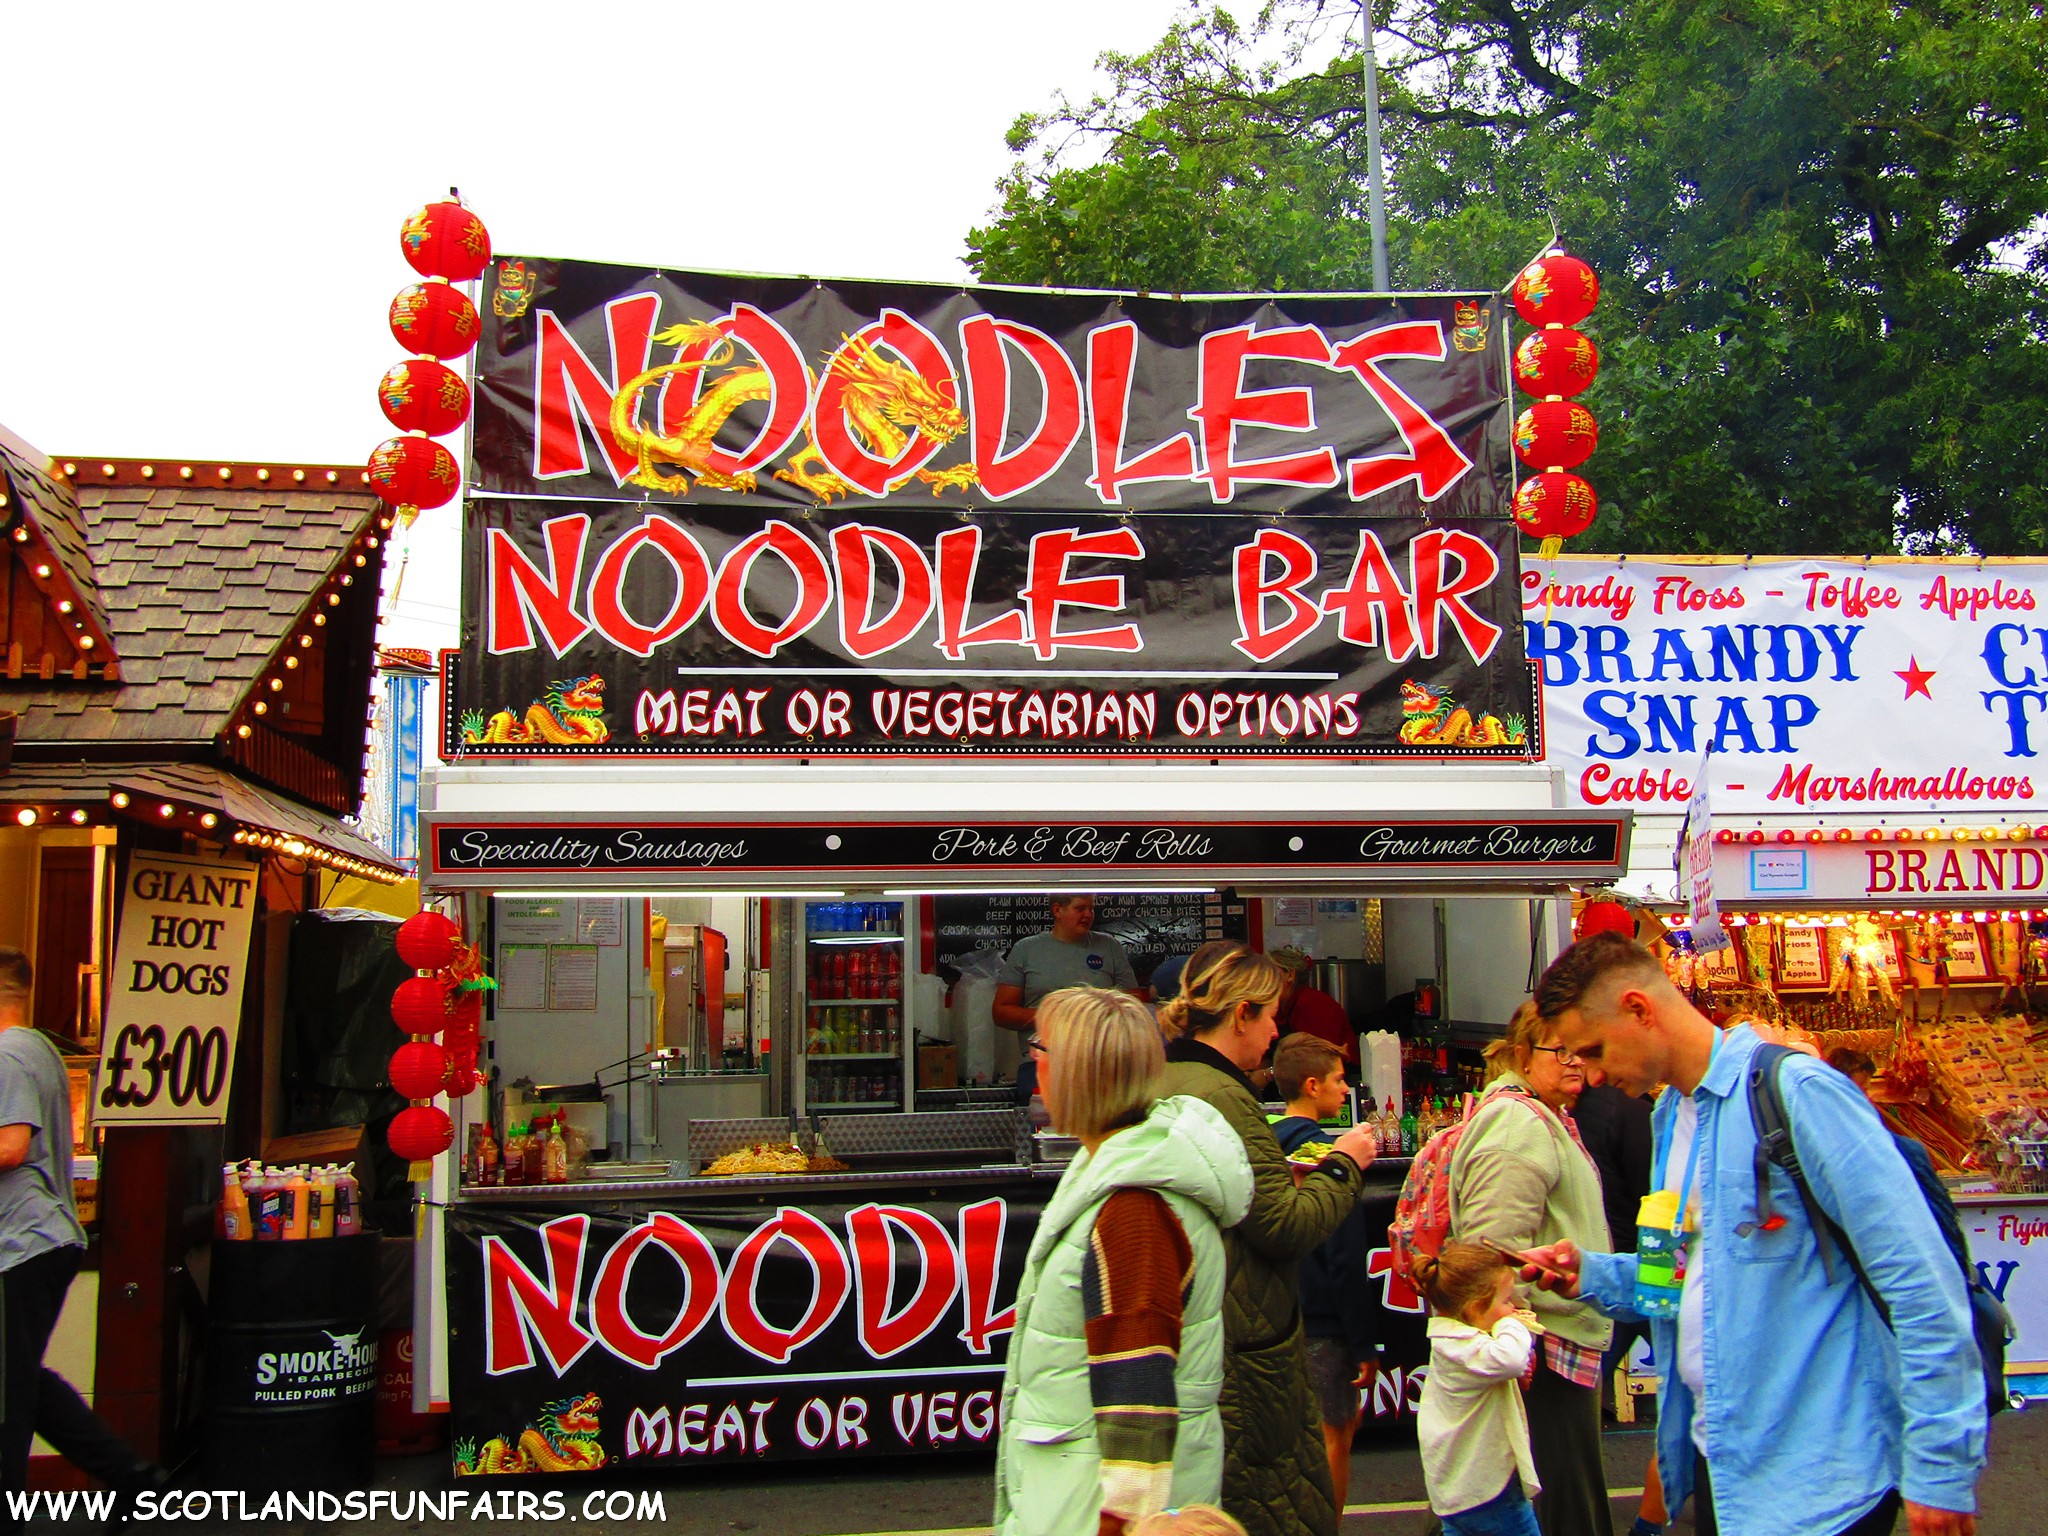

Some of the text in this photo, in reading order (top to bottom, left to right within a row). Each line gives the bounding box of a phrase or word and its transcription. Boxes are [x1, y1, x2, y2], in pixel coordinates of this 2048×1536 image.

[533, 291, 1474, 504] NOODLES
[487, 513, 1502, 666] NOODLE BAR
[1521, 571, 1636, 621] Candy
[1653, 576, 1745, 615] Floss
[1801, 572, 1902, 618] Toffee
[1919, 575, 2036, 621] Apples
[1523, 620, 1864, 686] BRANDY
[634, 688, 1361, 740] MEAT OR VEGETARIAN OPTIONS
[1583, 690, 1820, 759] SNAP
[1766, 763, 2034, 804] Marshmallows
[450, 831, 748, 867] Speciality Sausages
[932, 827, 1213, 863] Pork & Beef Rolls
[1360, 825, 1596, 863] Gourmet Burgers
[133, 868, 250, 909] GIANT
[988, 896, 1050, 907] PLAIN NOODLE
[1118, 896, 1136, 905] MINI
[1140, 895, 1169, 905] SPRING
[1173, 894, 1201, 904] ROLLS
[985, 910, 1054, 921] BEEF NOODLE
[1101, 907, 1130, 918] CRISPY
[1135, 907, 1172, 918] CHICKEN
[1176, 906, 1201, 916] BITES
[148, 915, 224, 950] HOT
[941, 925, 971, 936] CRISPY
[974, 925, 1012, 936] CHICKEN
[974, 939, 1012, 949] CHICKEN
[1952, 929, 1974, 942] andy
[939, 953, 956, 964] ADD
[1707, 966, 1737, 978] pcorn
[1953, 949, 1976, 964] Snap
[129, 960, 229, 996] DOGS
[1998, 1215, 2048, 1246] Flyin
[481, 1197, 1017, 1378] NOODL
[297, 1365, 374, 1383] BARBECUE
[384, 1372, 412, 1385] CAL
[255, 1390, 301, 1401] PULLED
[304, 1387, 336, 1400] PORK
[626, 1390, 1003, 1459] MEAT OR VEG
